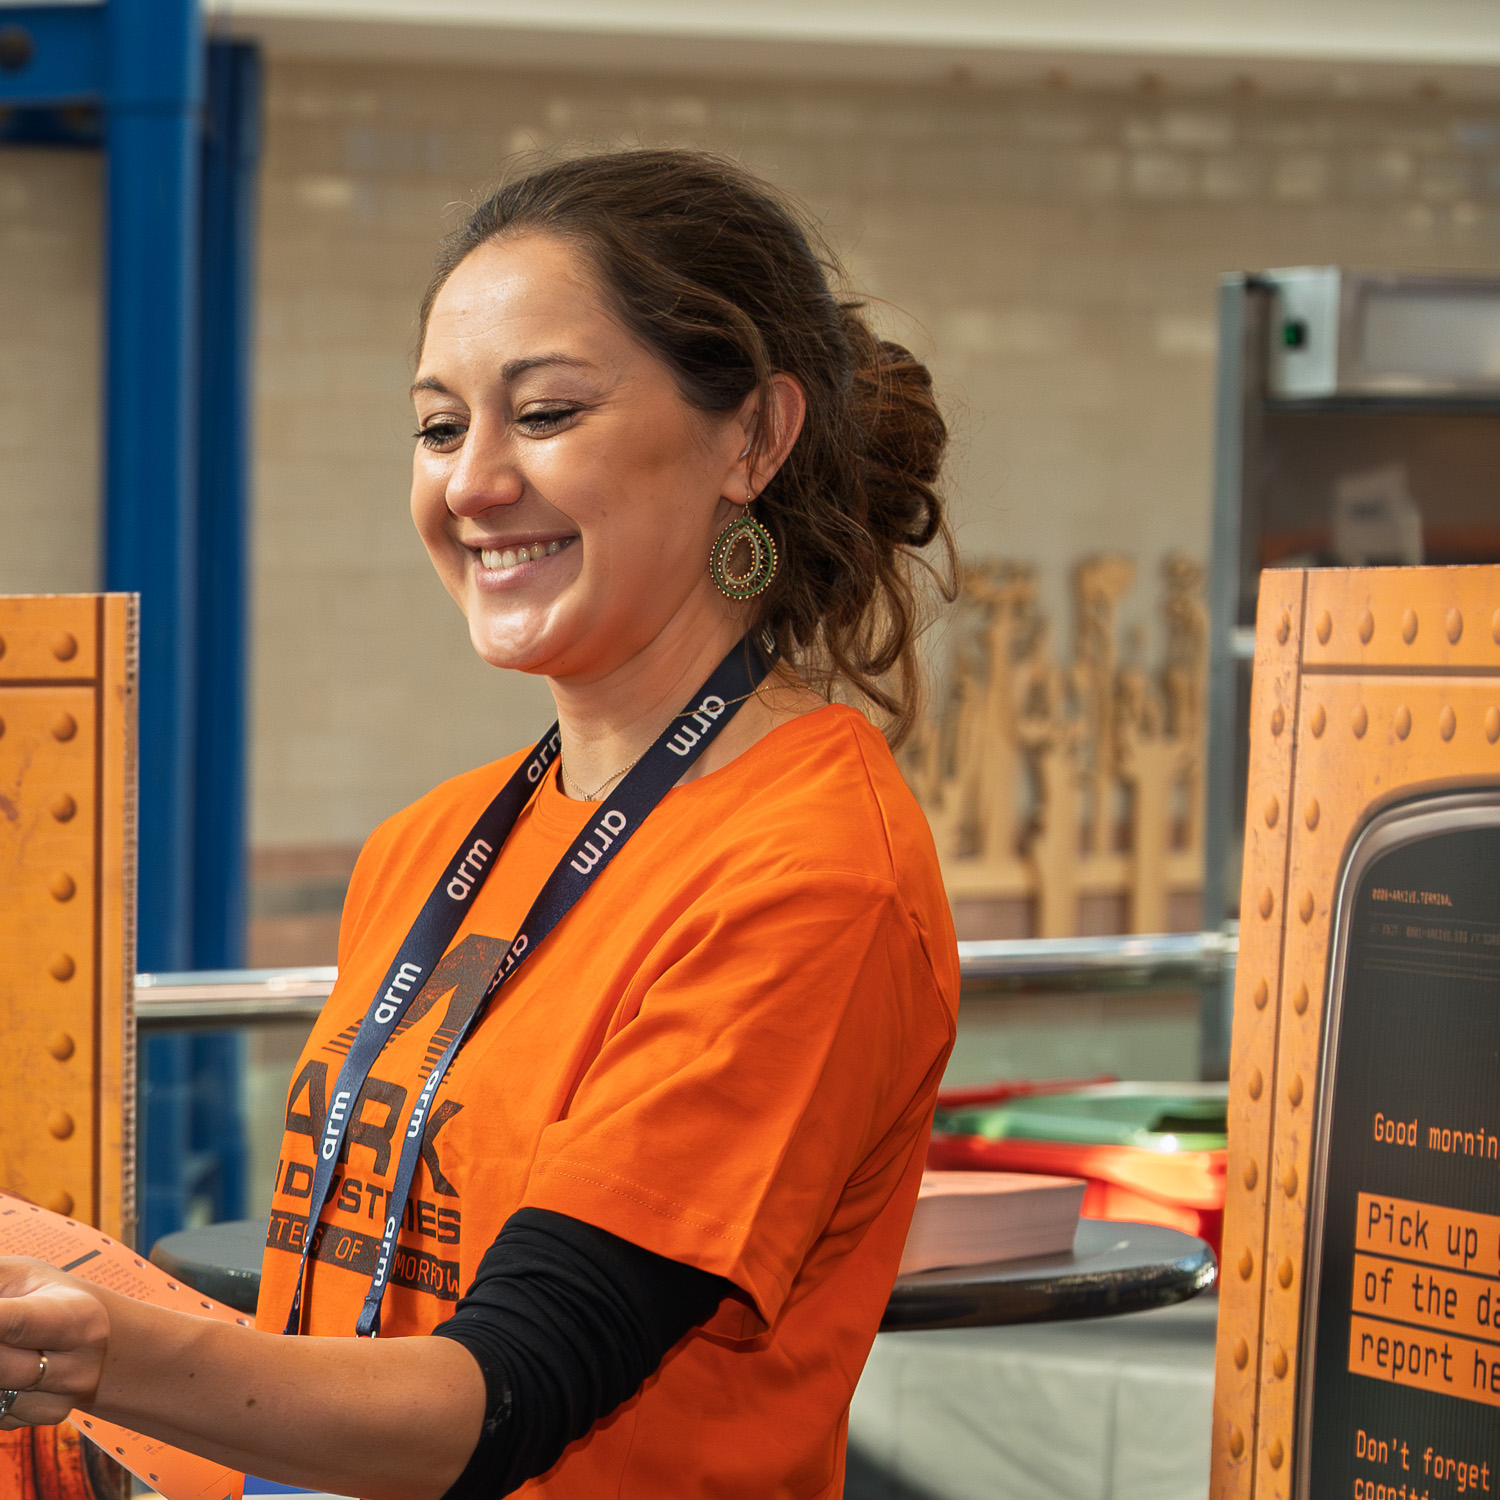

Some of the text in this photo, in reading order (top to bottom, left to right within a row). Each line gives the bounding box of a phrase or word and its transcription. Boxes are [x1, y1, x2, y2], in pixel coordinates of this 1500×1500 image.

[666, 695, 726, 756] arm
[446, 838, 493, 901] arm
[570, 809, 627, 875] arm
[374, 962, 423, 1025] arm
[322, 1091, 350, 1160] arm
[406, 1070, 440, 1138] arm
[1374, 1112, 1500, 1172] Good mornin
[335, 1236, 363, 1261] OF
[373, 1216, 396, 1287] arm
[1368, 1202, 1429, 1250] Pick
[1447, 1224, 1478, 1268] up
[1365, 1267, 1394, 1305] of
[1411, 1272, 1458, 1320] the
[1361, 1332, 1453, 1382] report
[1356, 1429, 1490, 1493] Don't forget
